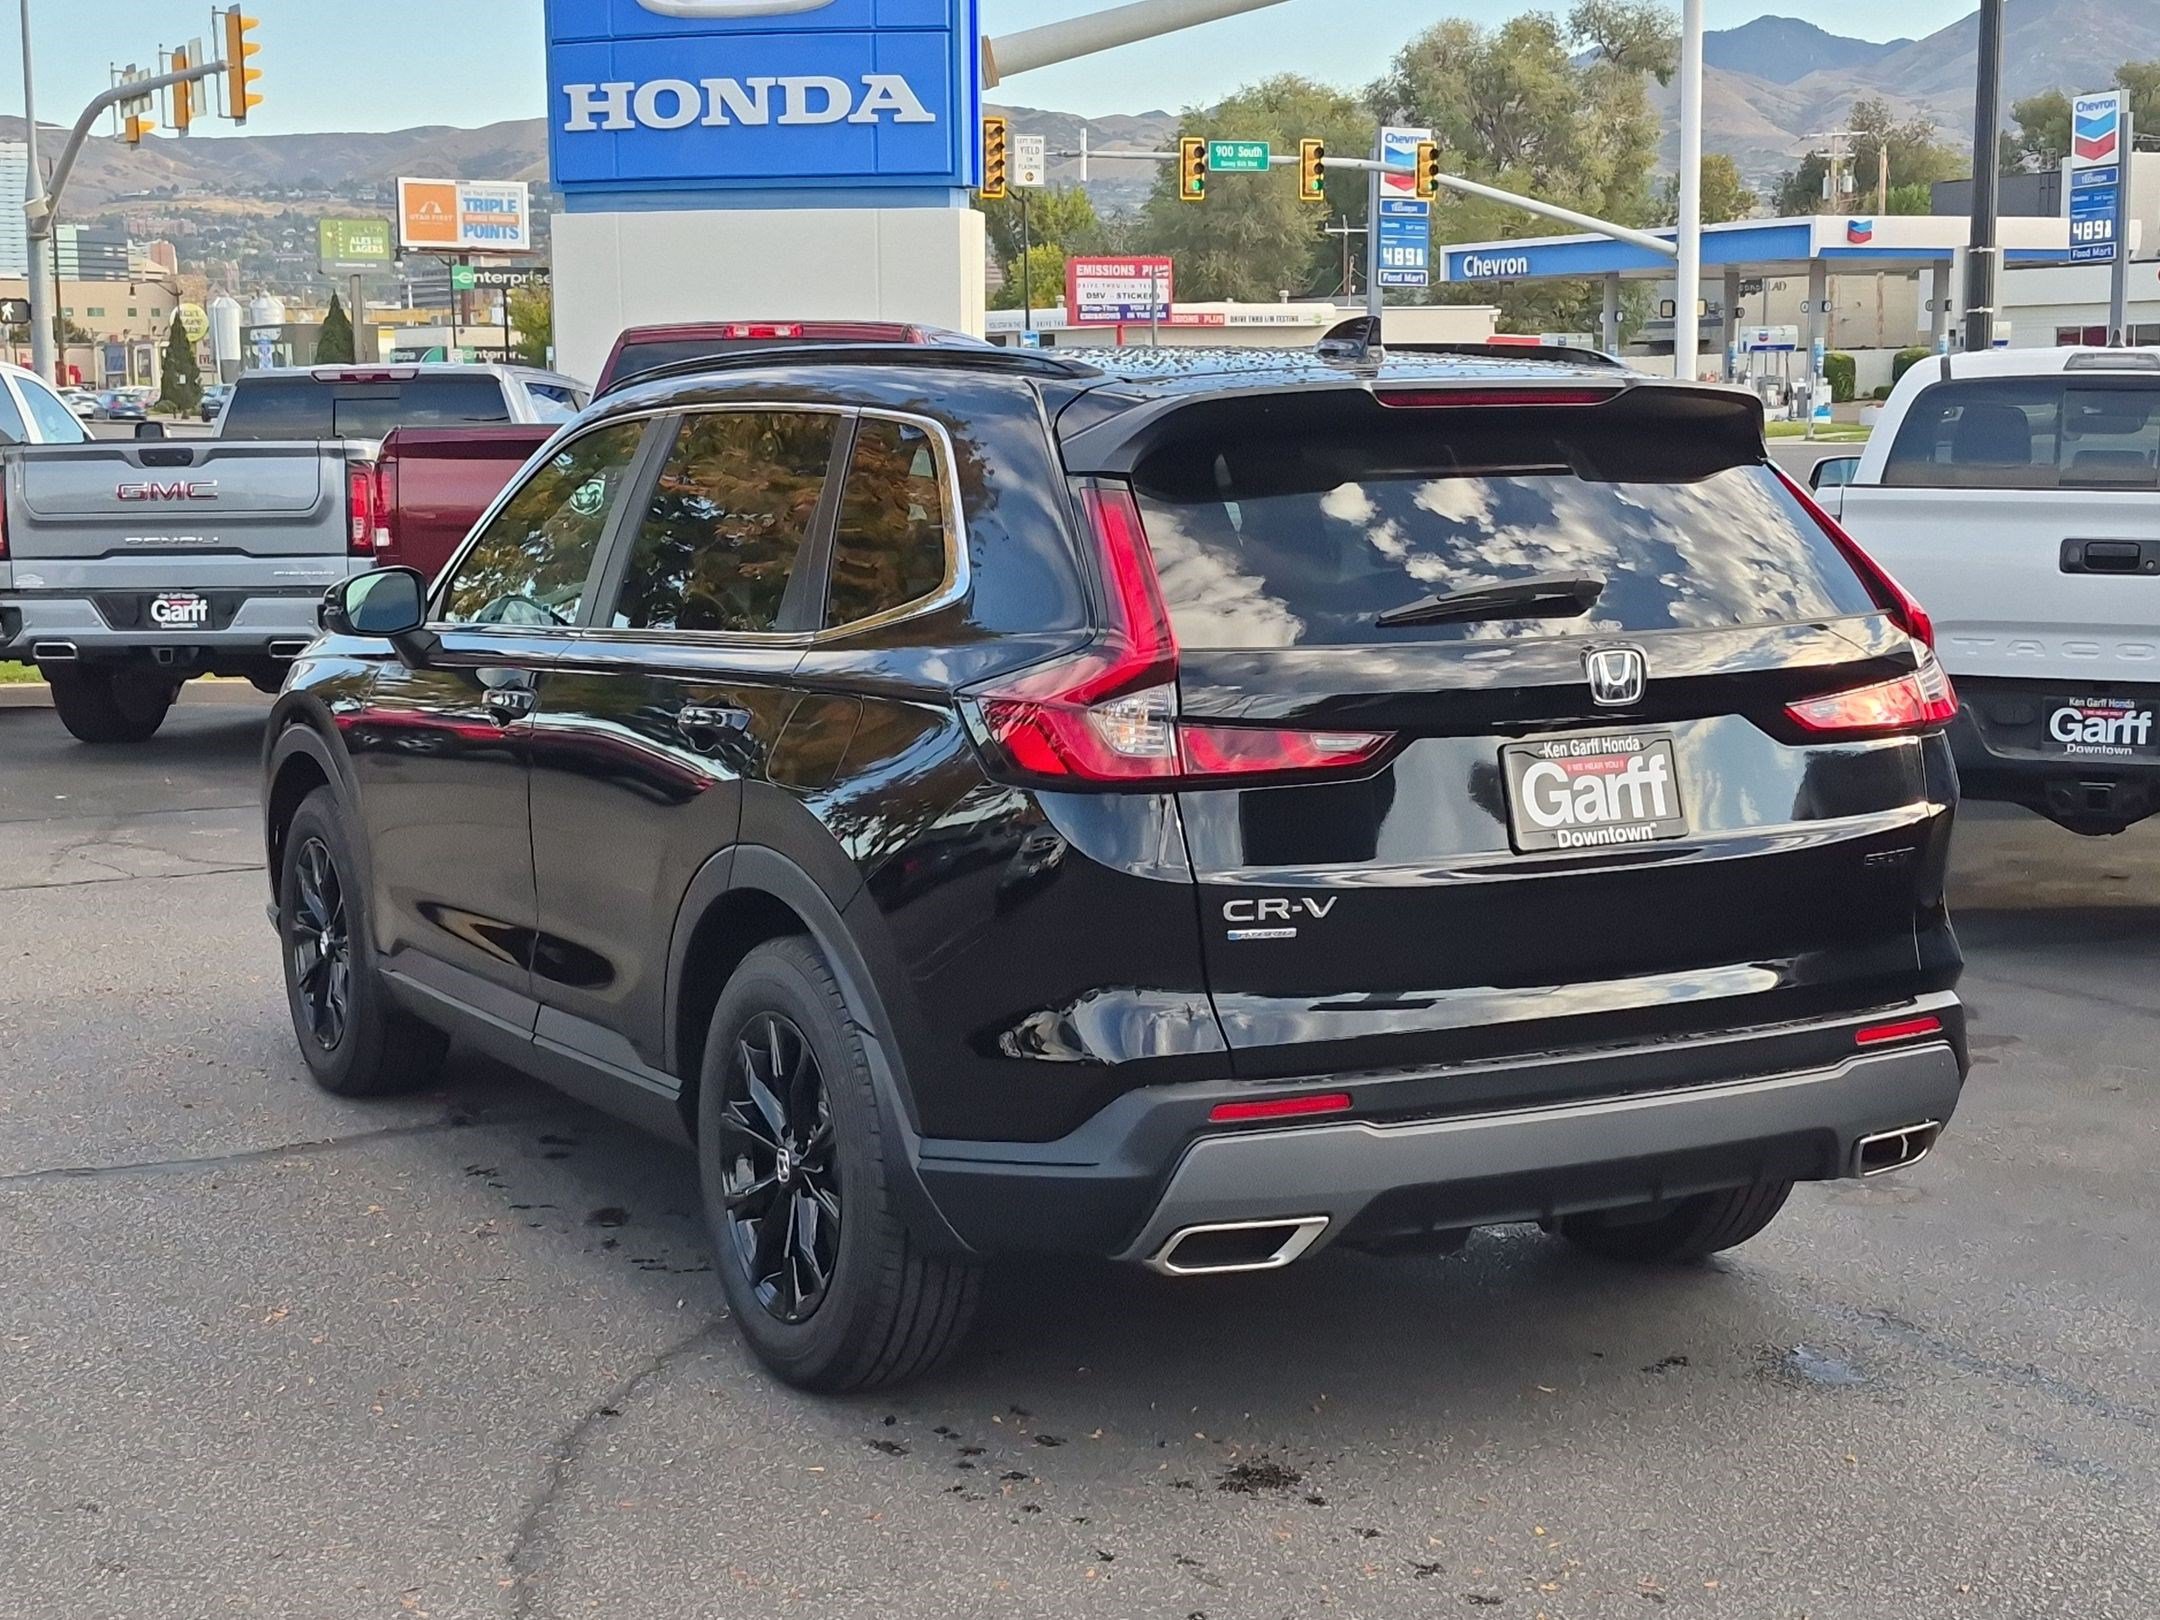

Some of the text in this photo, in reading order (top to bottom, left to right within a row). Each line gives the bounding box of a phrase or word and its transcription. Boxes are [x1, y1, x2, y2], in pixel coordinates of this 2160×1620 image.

[563, 75, 936, 131] HONDA
[2076, 99, 2116, 112] Chevron
[1020, 146, 1040, 155] YIELD
[1215, 145, 1263, 158] 900 South
[463, 198, 517, 213] TRIPLE
[463, 224, 519, 240] POINTS
[2073, 247, 2112, 259] Food Mart
[1077, 265, 1136, 276] EMISSIONS
[1463, 255, 1528, 277] Chevron
[1383, 273, 1425, 283] Food Mart
[1204, 314, 1225, 324] PLUS
[116, 480, 218, 500] GMC
[125, 536, 219, 545] DENALI
[150, 599, 208, 622] Garff
[2069, 698, 2135, 708] Ken Garff Honda
[2050, 707, 2152, 745] Garff
[1543, 736, 1640, 759] Ken Garff Honda
[2066, 743, 2132, 755] Downtown
[1522, 754, 1668, 827] Garff
[1557, 825, 1653, 848] Downtown
[1223, 896, 1338, 921] CR-V
